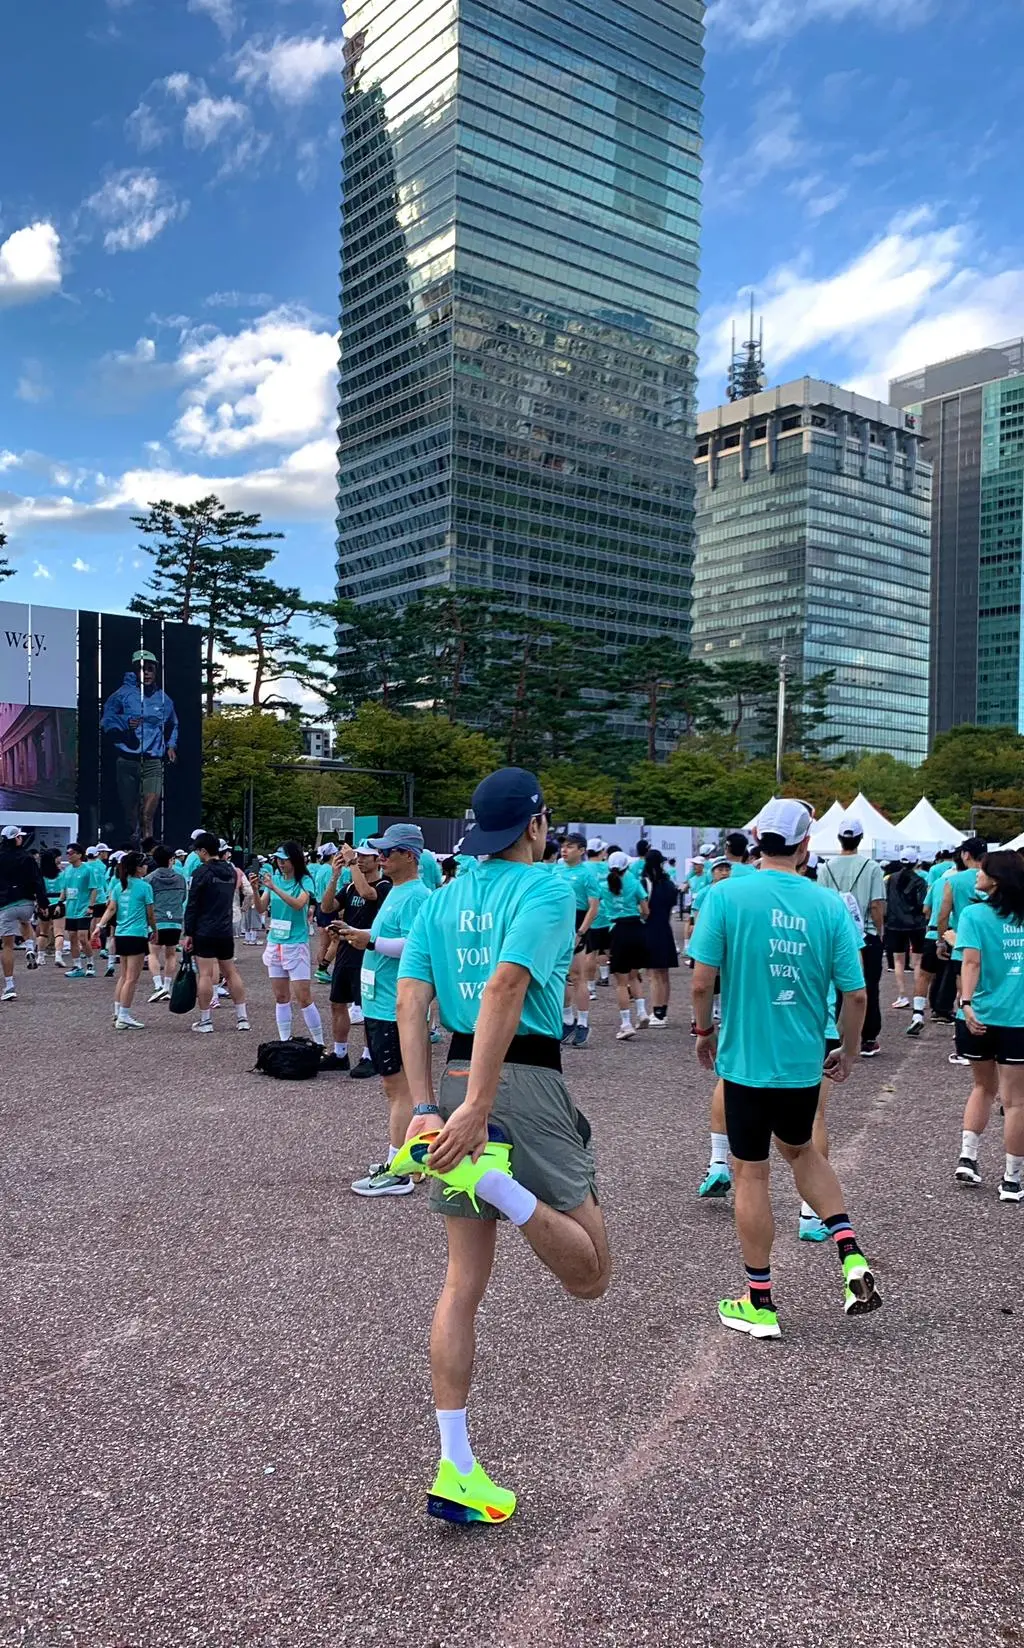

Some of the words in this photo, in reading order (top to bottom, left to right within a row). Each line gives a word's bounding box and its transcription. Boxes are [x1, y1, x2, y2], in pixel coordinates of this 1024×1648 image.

[4, 631, 47, 656] way.
[661, 840, 677, 850] Run
[459, 908, 494, 932] Run
[771, 908, 807, 932] Run
[769, 938, 807, 957] your
